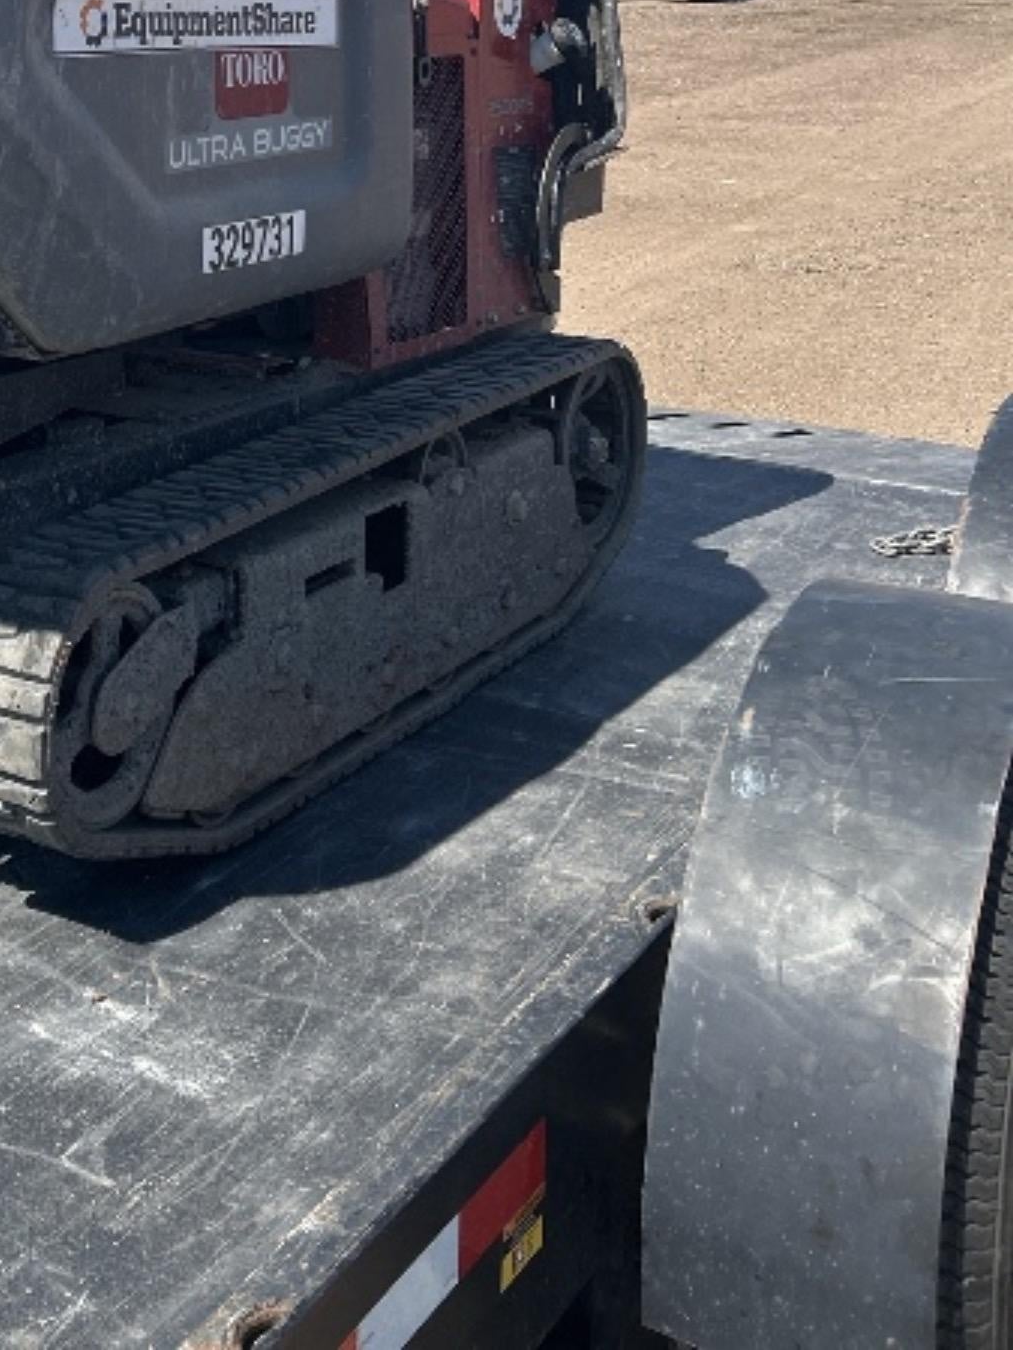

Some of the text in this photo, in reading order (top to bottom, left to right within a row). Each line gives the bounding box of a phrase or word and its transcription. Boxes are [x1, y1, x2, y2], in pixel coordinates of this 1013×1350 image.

[112, 2, 317, 45] EquipmentShare
[220, 50, 286, 88] TORO
[169, 119, 329, 169] ULTRA BUGGY
[208, 215, 296, 273] 329731
